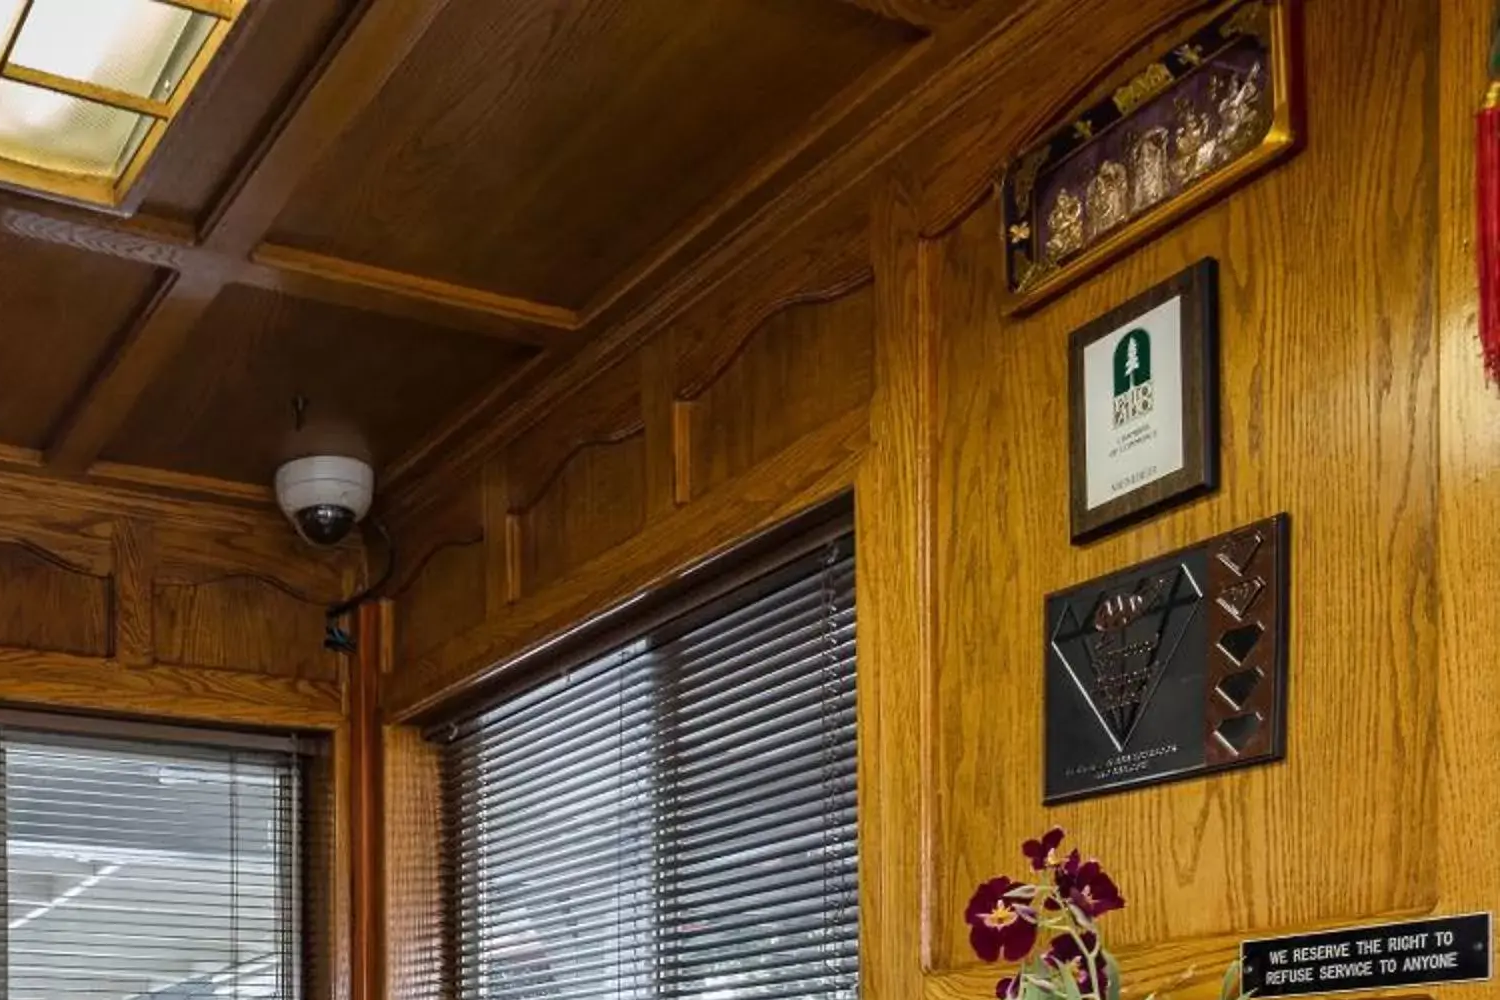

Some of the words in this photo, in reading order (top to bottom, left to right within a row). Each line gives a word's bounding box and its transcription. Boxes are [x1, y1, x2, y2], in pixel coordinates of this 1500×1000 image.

[1269, 949, 1288, 965] WE
[1293, 942, 1350, 963] RESERVE
[1356, 939, 1382, 955] THE
[1388, 933, 1428, 952] RIGHT
[1434, 931, 1453, 946] TO
[1265, 967, 1314, 985] REFUSE
[1319, 961, 1373, 979] SERVICE
[1380, 958, 1397, 974] TO
[1402, 951, 1459, 972] ANYONE
